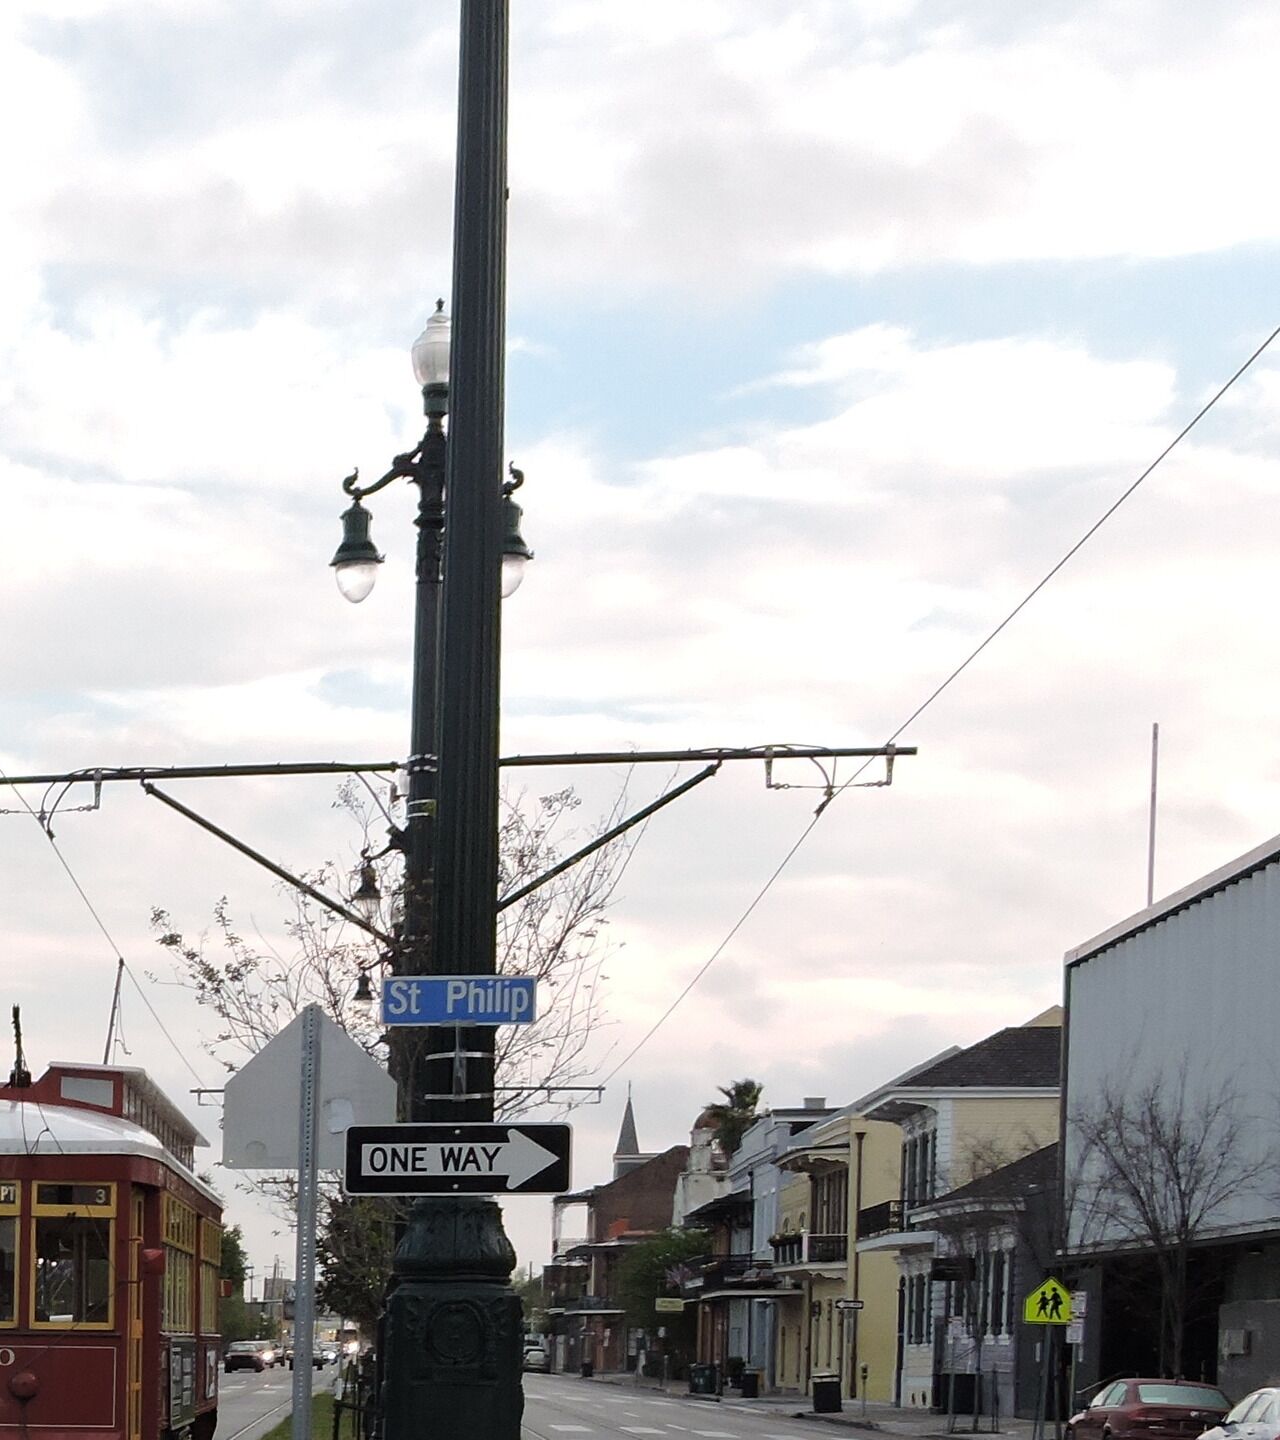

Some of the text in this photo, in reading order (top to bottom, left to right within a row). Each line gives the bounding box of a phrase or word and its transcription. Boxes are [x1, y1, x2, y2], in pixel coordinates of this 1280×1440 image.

[388, 980, 529, 1020] St Philip
[369, 1146, 503, 1173] ONE WAY
[95, 1189, 107, 1203] 3
